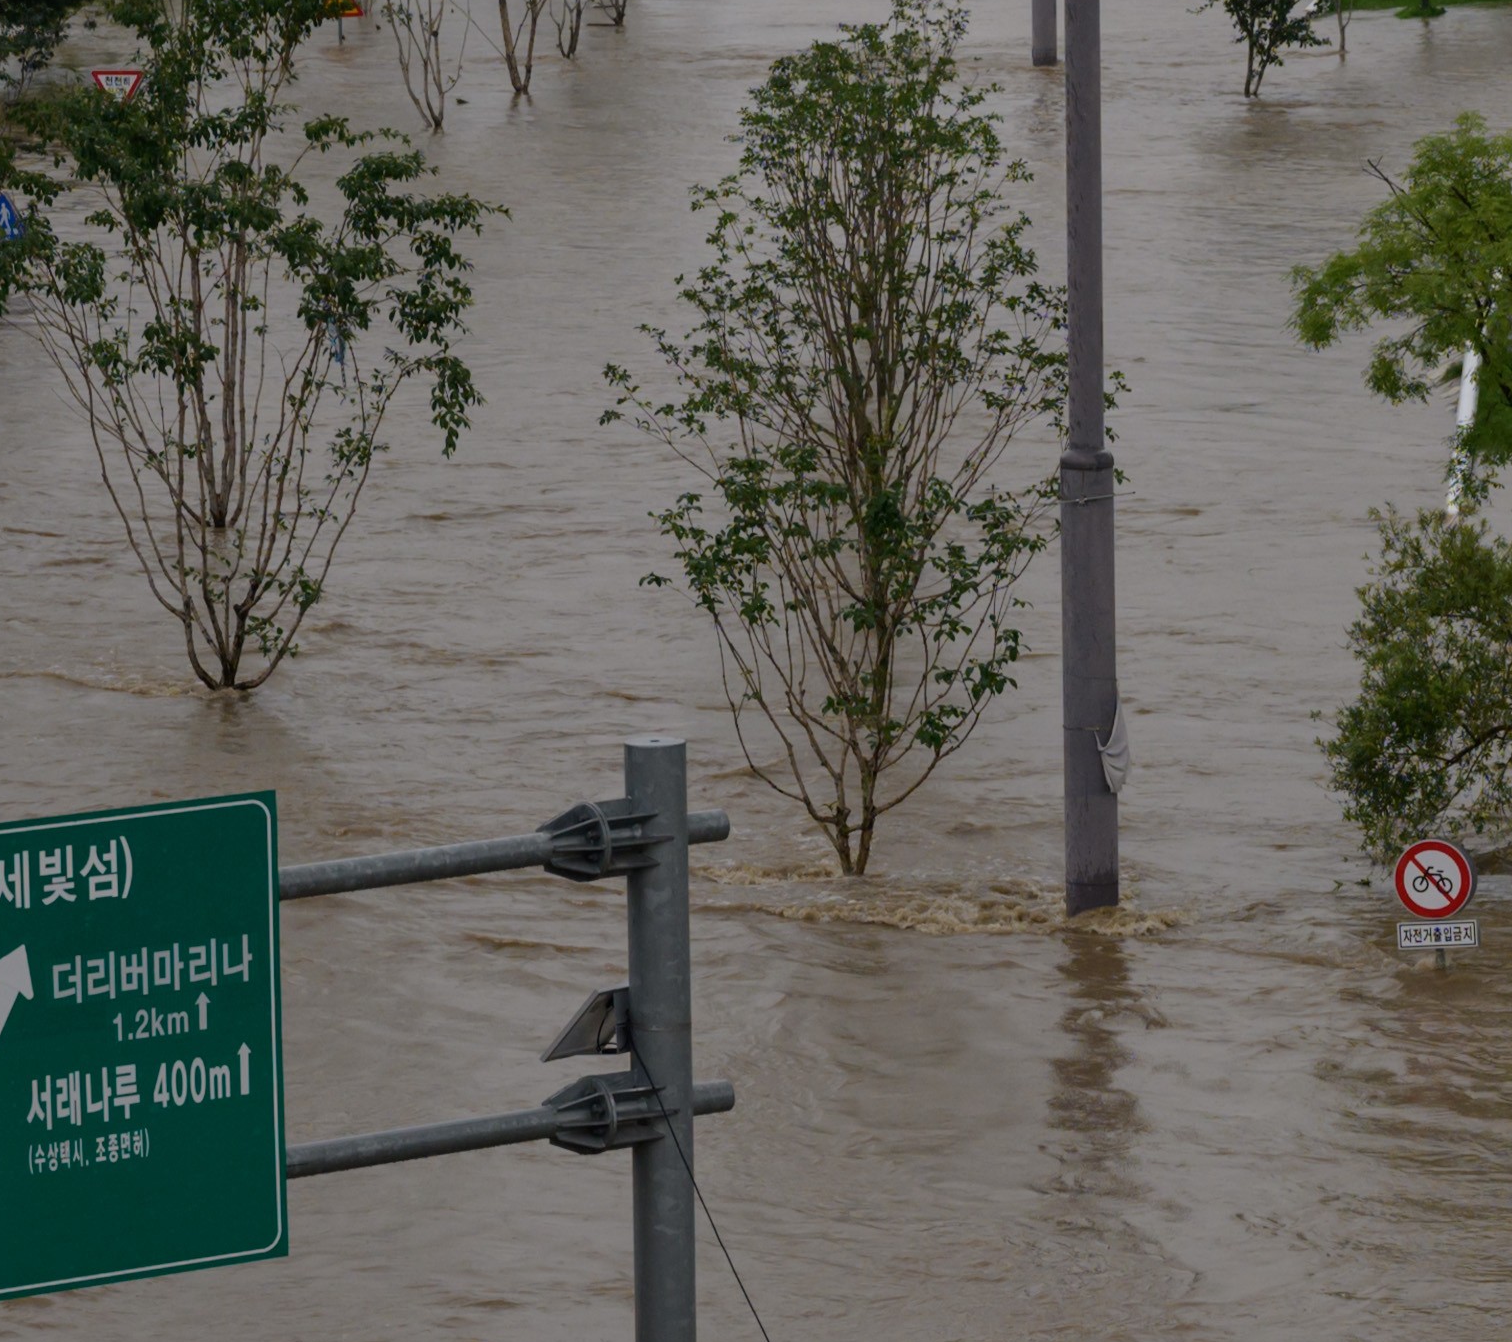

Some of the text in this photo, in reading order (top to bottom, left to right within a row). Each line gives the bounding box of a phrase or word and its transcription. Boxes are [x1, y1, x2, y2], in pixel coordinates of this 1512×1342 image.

[1403, 926, 1472, 943] 자전거출입금지
[52, 934, 253, 1004] 더리버마리나
[112, 1007, 189, 1042] 1.2km
[26, 1058, 231, 1131] 서래나루 400m
[95, 1127, 150, 1163] 조종면허)
